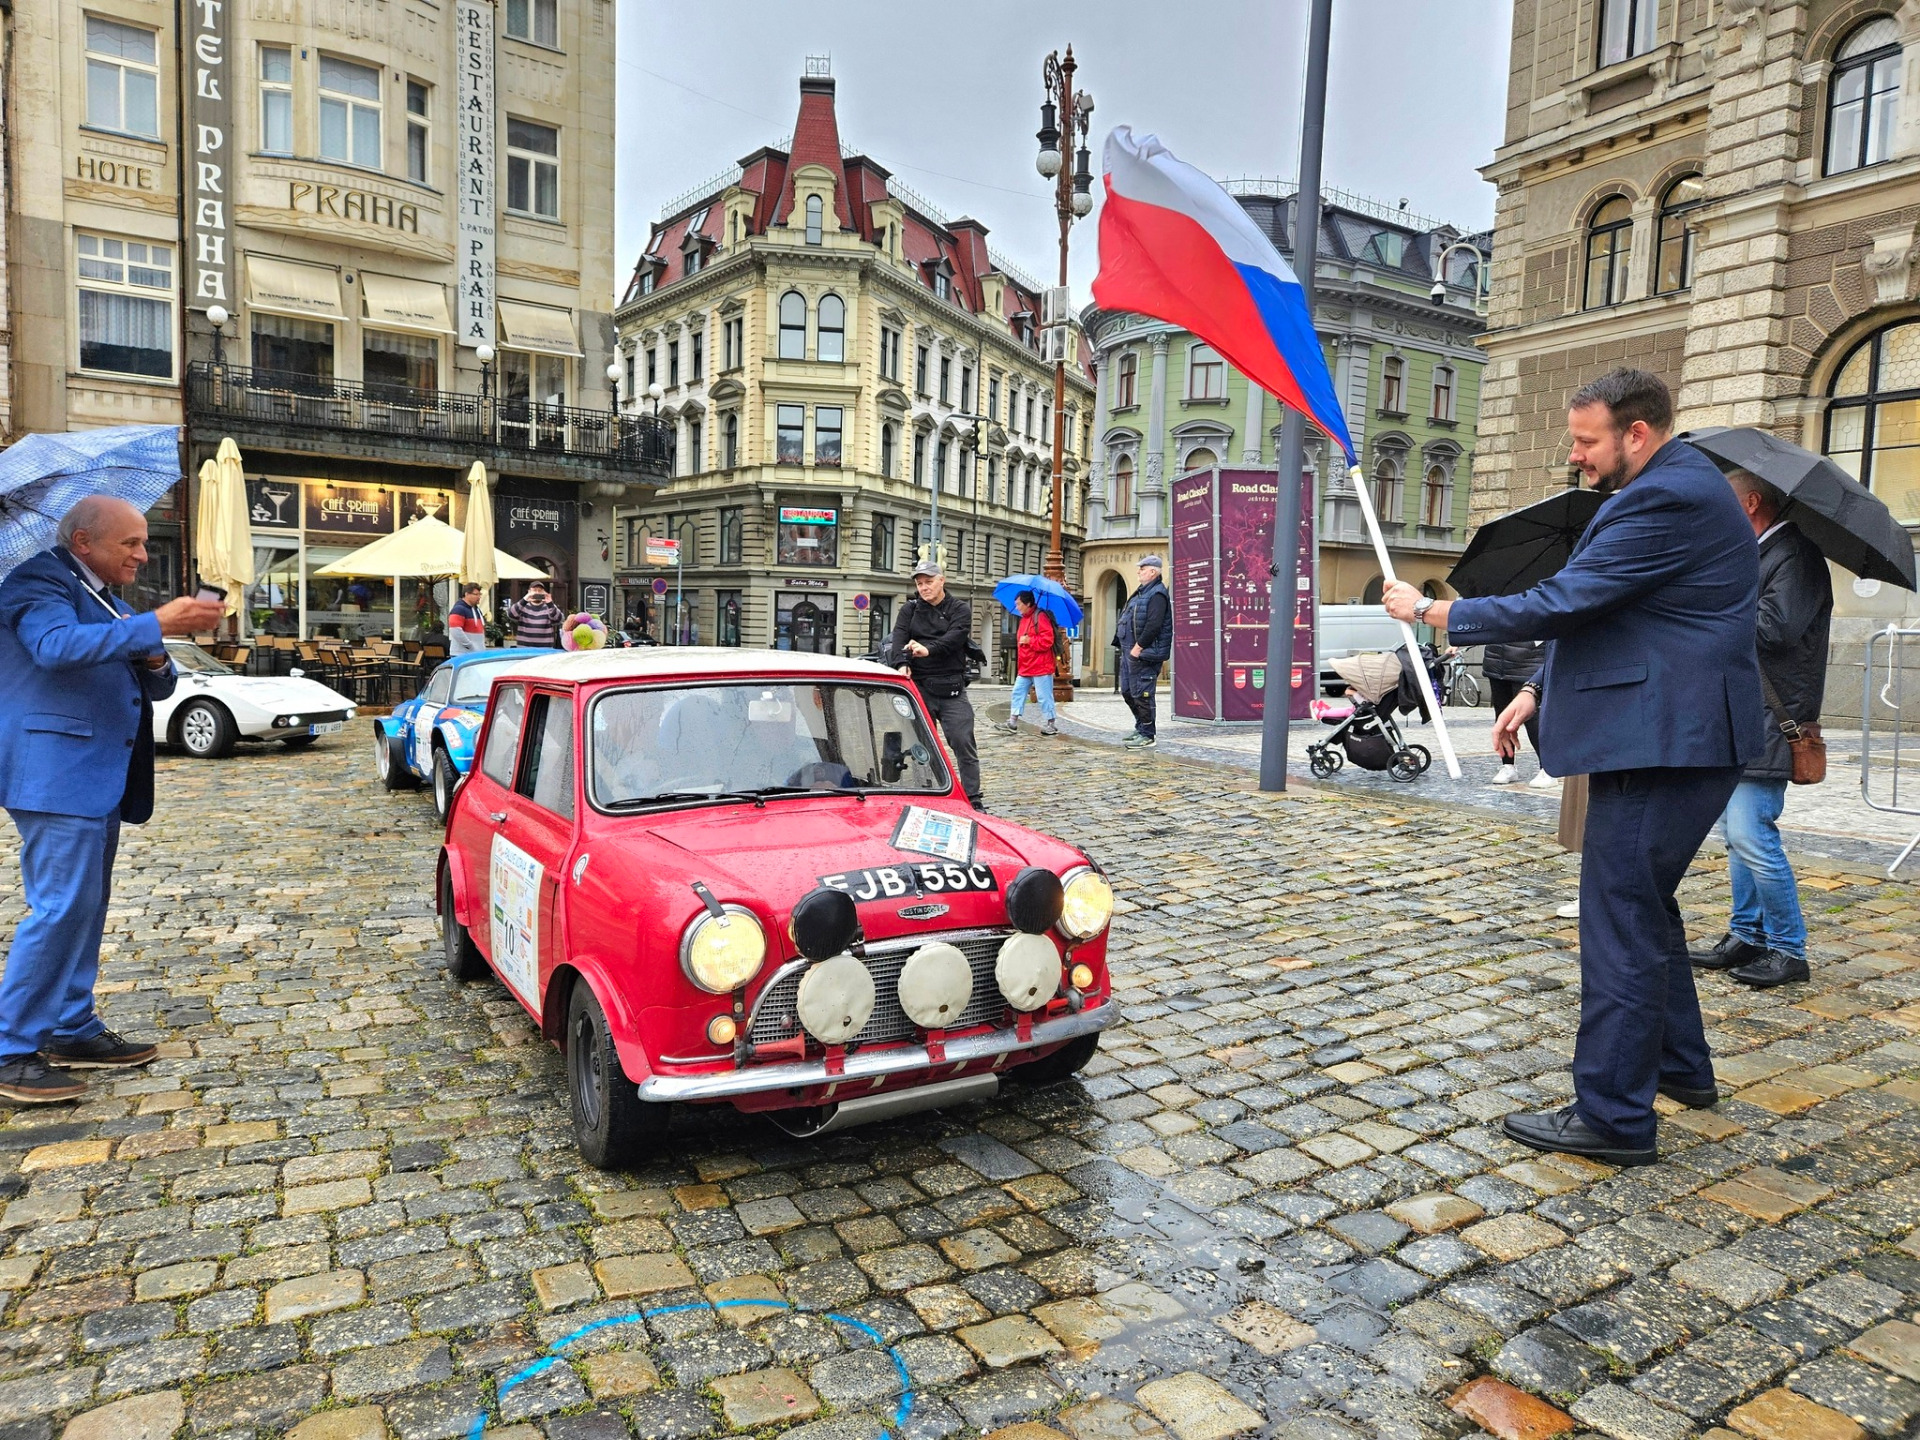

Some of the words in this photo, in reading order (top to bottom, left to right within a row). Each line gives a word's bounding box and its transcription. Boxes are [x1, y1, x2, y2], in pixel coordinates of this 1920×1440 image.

[466, 9, 485, 216] RESTAURANT
[196, 123, 227, 301] PRAHA
[289, 182, 418, 235] PRAHA
[467, 224, 494, 235] PATRO
[459, 274, 467, 299] ART
[469, 239, 486, 339] PRAHA
[486, 262, 494, 321] NOUVEAU
[1177, 490, 1190, 503] Road
[1189, 485, 1209, 500] Classics
[1232, 484, 1259, 494] Road
[346, 499, 379, 514] PRAHA
[531, 508, 559, 521] PRAHA
[919, 864, 991, 891] 55C
[504, 919, 515, 956] 10
